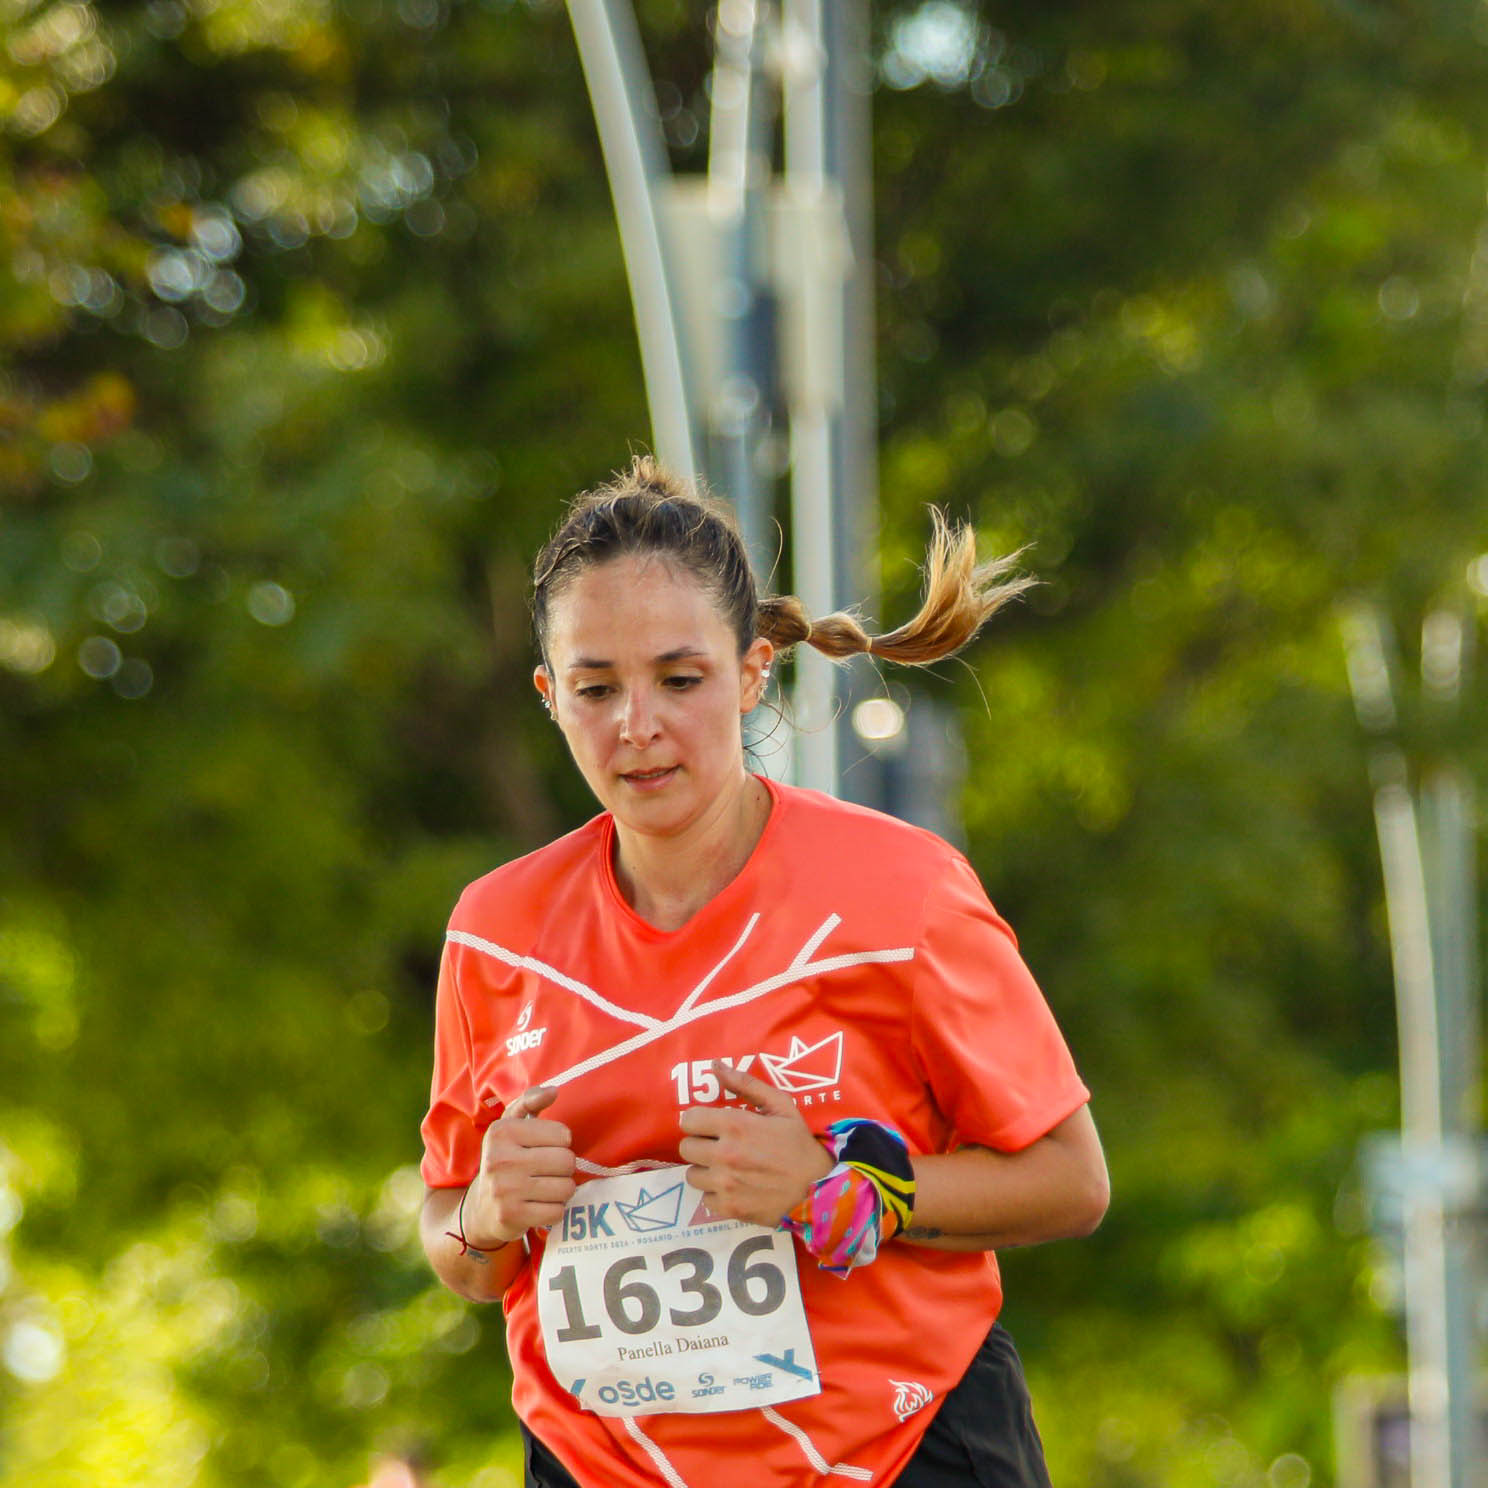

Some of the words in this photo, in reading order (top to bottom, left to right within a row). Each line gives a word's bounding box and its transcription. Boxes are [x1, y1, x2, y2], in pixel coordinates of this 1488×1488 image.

[561, 1202, 616, 1242] 15K
[548, 1234, 787, 1343] 1636
[617, 1341, 672, 1361] Panella
[676, 1335, 729, 1353] Daiana
[598, 1376, 675, 1406] osde
